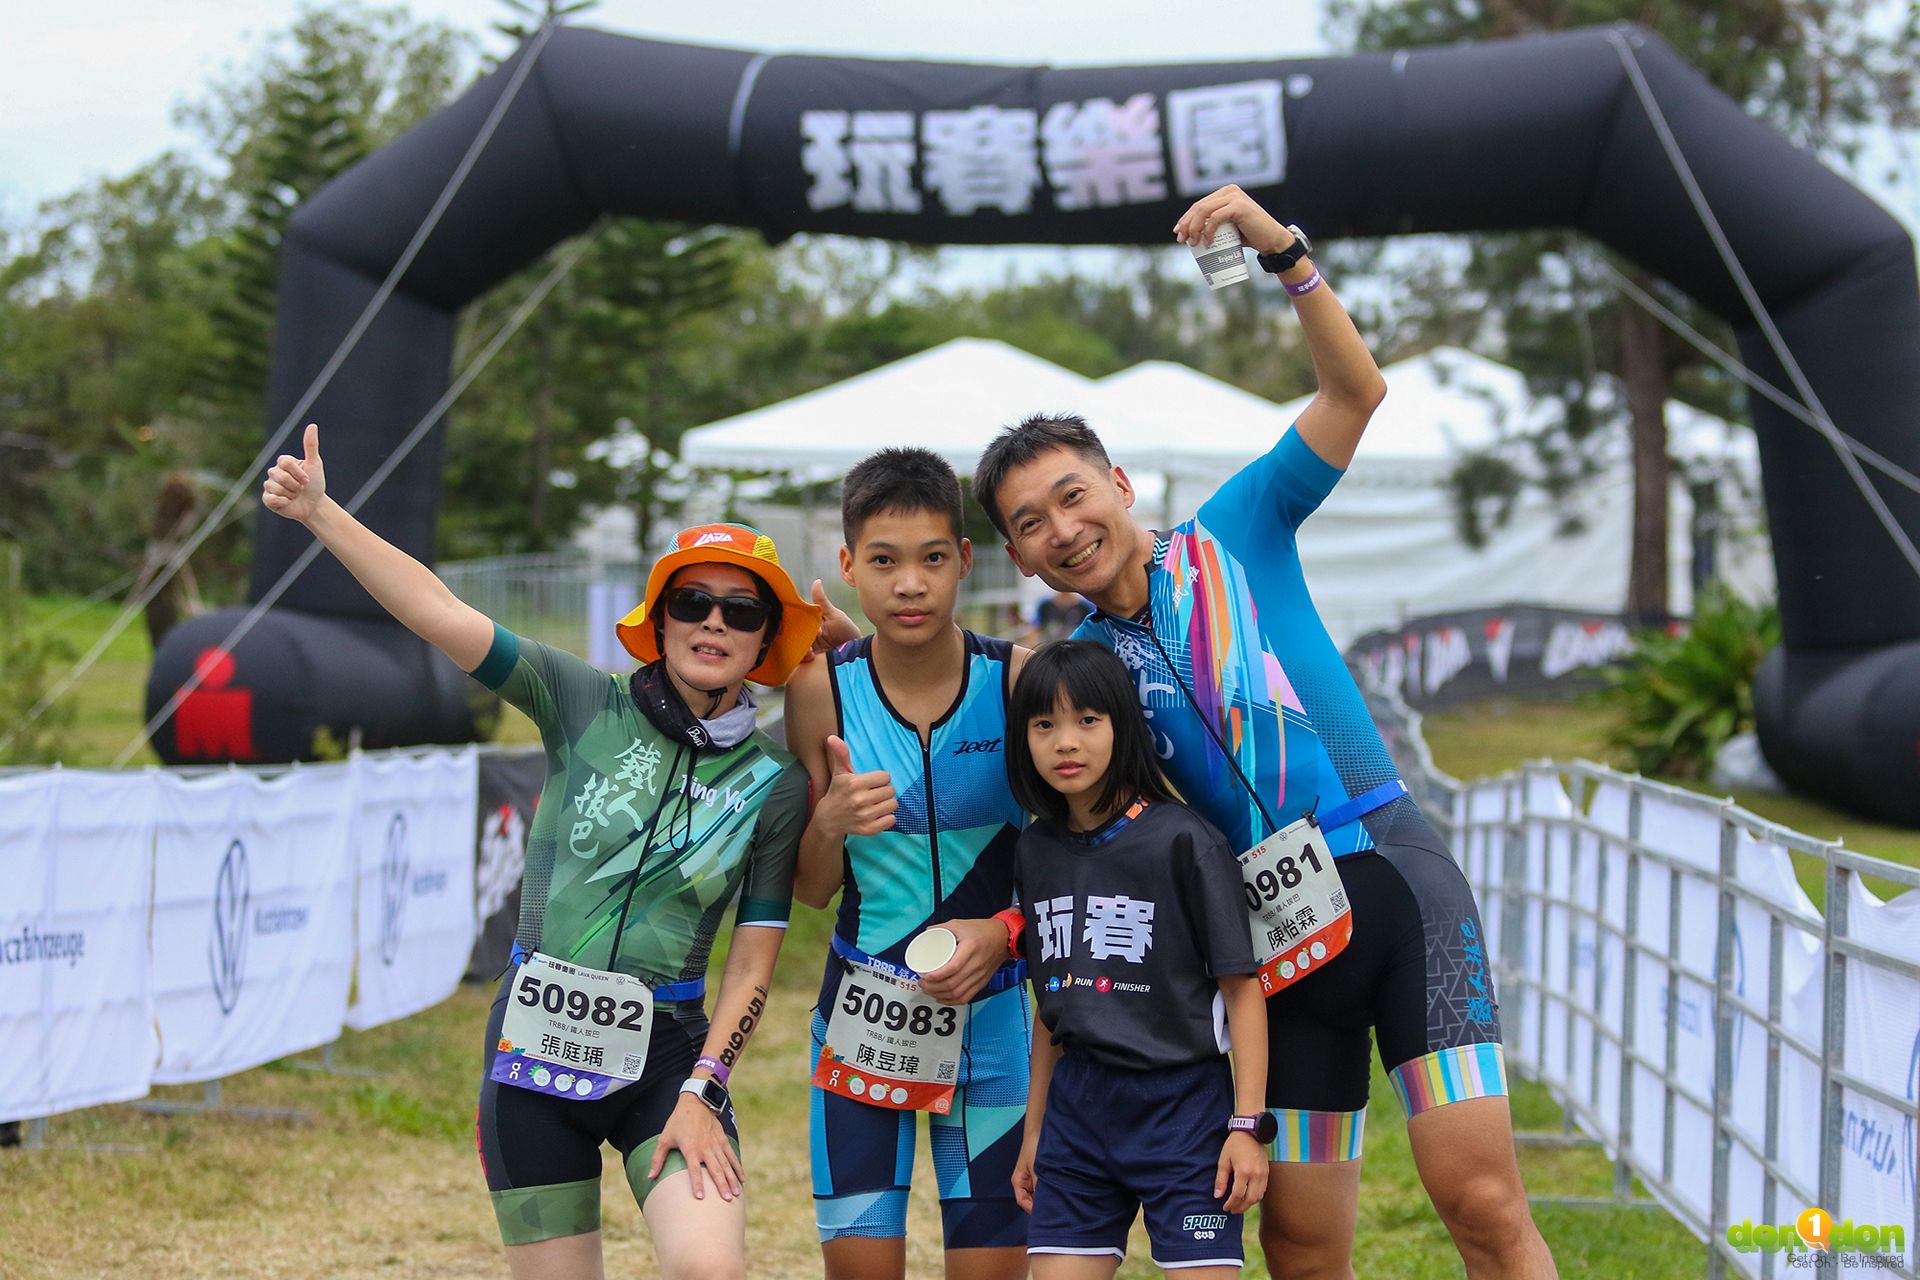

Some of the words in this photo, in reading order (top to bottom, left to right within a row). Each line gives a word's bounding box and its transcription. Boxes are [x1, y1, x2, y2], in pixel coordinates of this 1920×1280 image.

[801, 80, 1287, 215] 玩賽樂園
[1251, 845, 1267, 859] 515
[1244, 842, 1323, 912] 0981
[1034, 895, 1155, 963] 玩賽
[1267, 904, 1318, 951] 陳怡霖
[591, 973, 609, 982] QUEEN
[900, 981, 917, 992] 515
[1074, 977, 1094, 987] RUN
[1113, 982, 1151, 993] FINISHER
[517, 975, 644, 1032] 50982
[842, 983, 956, 1037] 50983
[540, 1033, 604, 1067] 張庭瑀
[713, 997, 765, 1082] 5098
[856, 1043, 920, 1076] 陳昱瑋
[1183, 1214, 1228, 1231] SPORT
